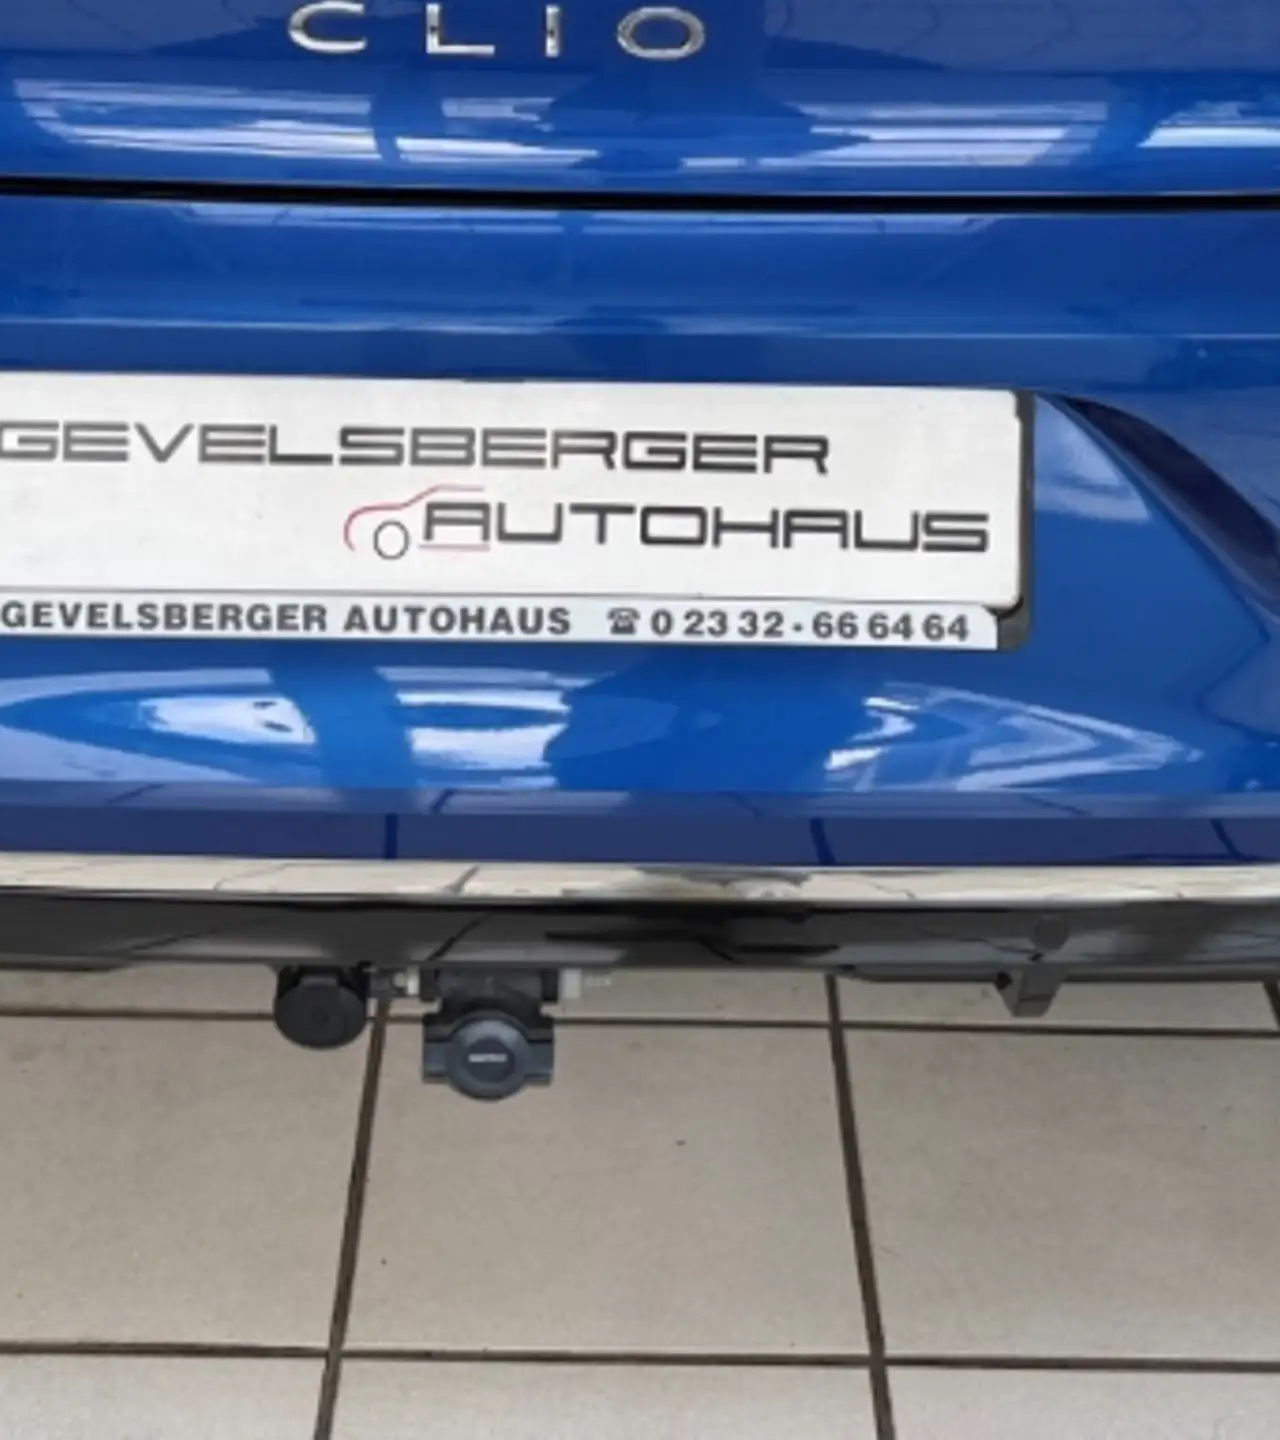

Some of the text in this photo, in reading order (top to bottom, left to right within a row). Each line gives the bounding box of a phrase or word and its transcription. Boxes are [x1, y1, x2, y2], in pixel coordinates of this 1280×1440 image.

[289, 0, 704, 61] CLIO
[424, 501, 988, 553] AUTOHAUS
[0, 600, 327, 632] GEVELSBERGER
[342, 605, 571, 635] AUTOHAUS
[650, 609, 674, 636] 0
